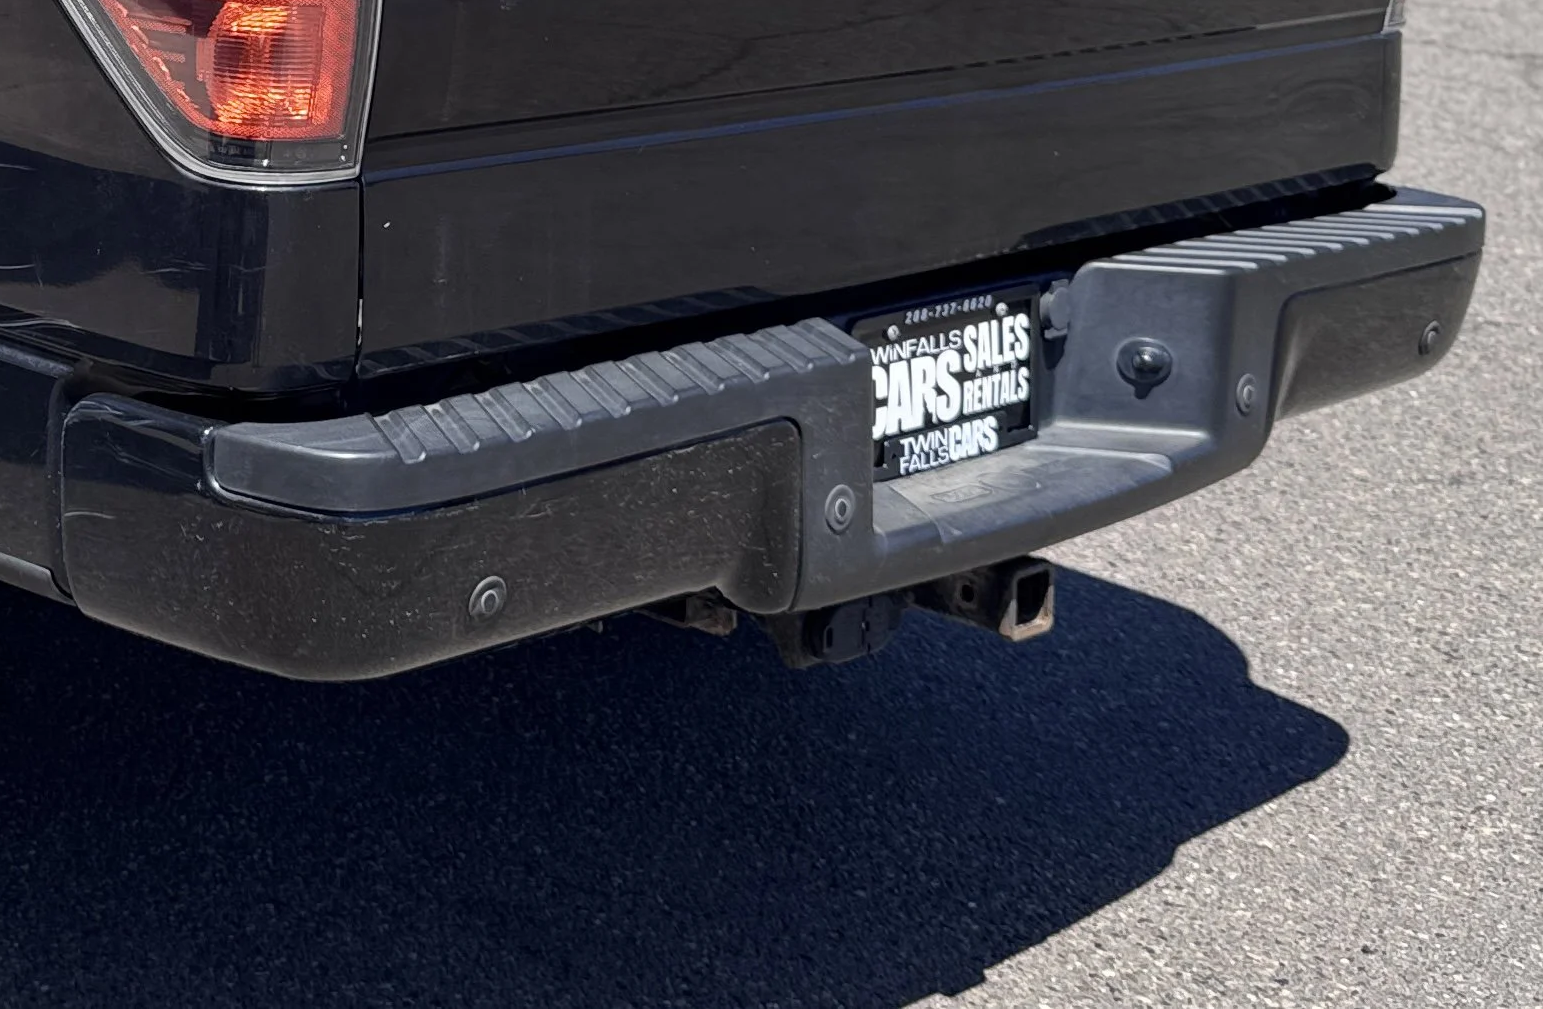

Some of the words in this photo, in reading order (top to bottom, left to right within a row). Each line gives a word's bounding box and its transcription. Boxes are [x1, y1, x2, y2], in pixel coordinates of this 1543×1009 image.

[963, 313, 1030, 373] SALES
[872, 349, 962, 441] CARS
[962, 366, 1030, 416] RENTALS
[899, 428, 948, 457] TWIN
[899, 447, 950, 476] FALLS
[947, 415, 999, 462] CARS
